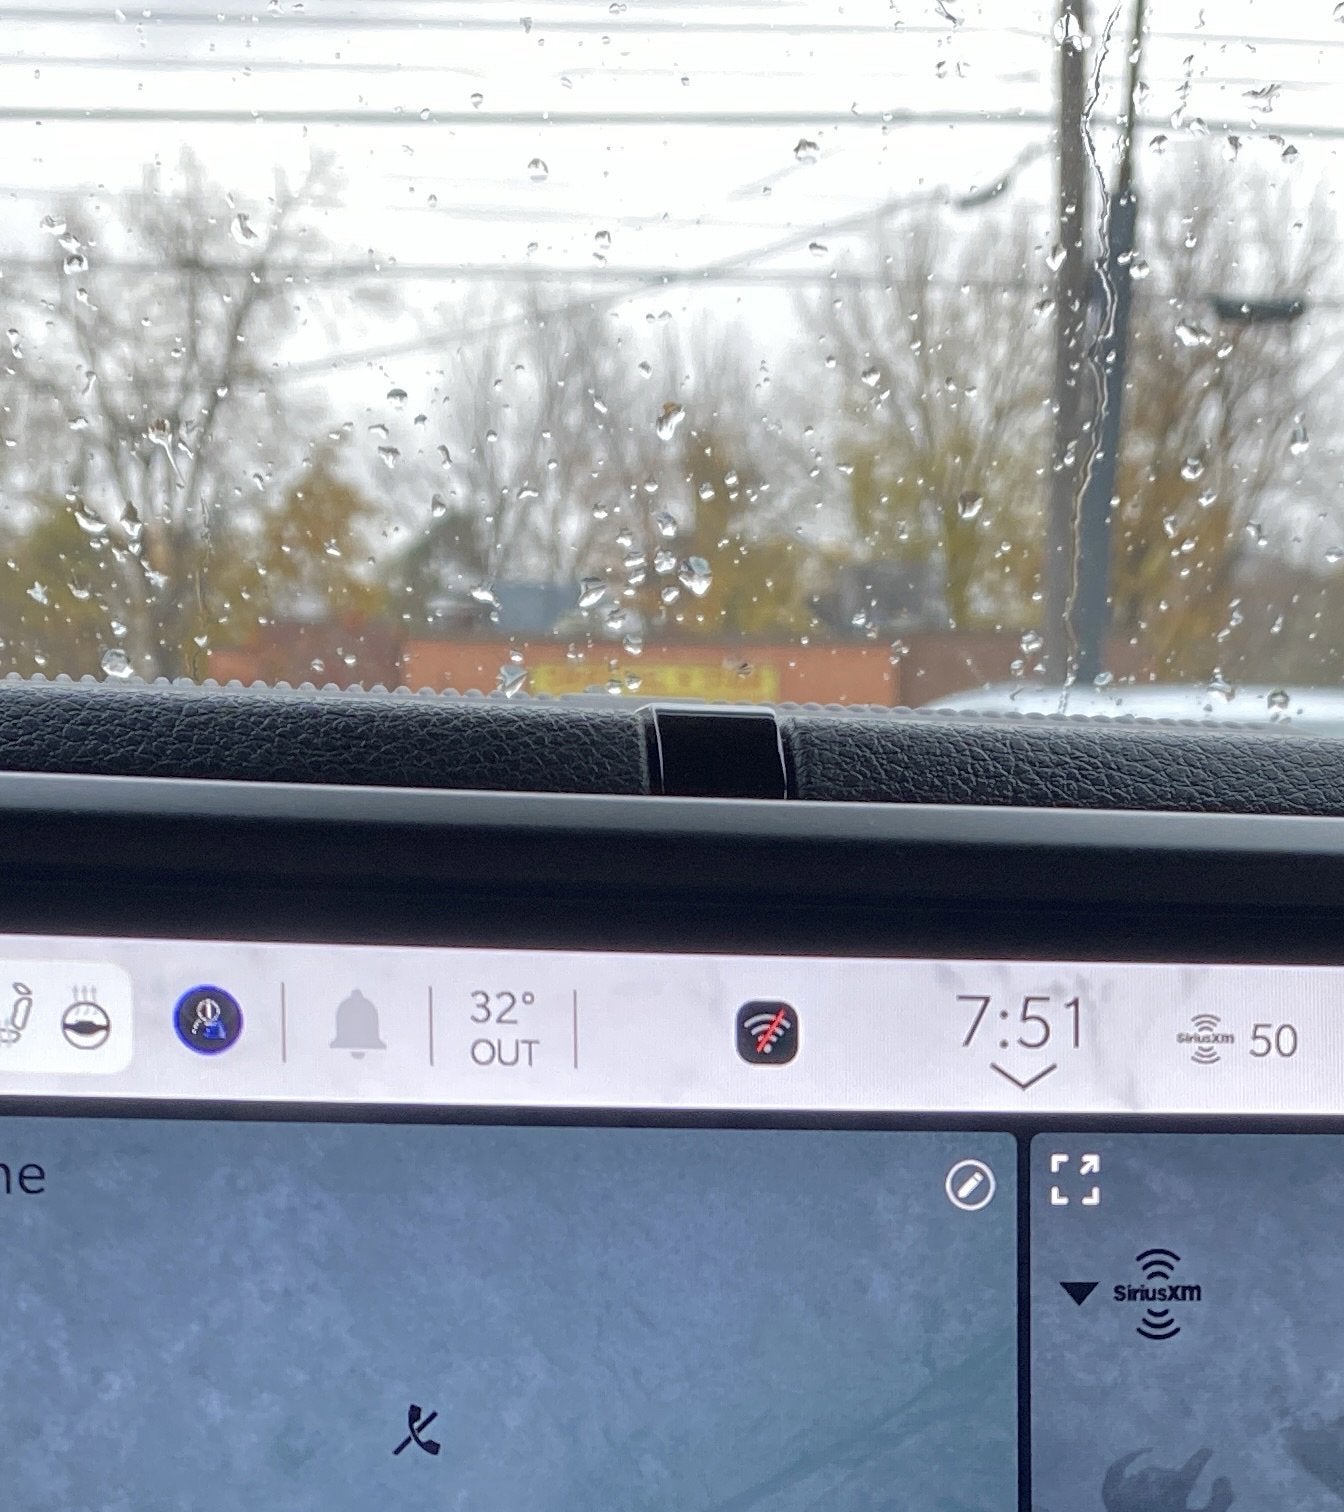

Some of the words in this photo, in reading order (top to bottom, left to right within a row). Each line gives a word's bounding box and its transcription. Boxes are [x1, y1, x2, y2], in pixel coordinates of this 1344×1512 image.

[469, 990, 535, 1025] 32°
[955, 994, 1081, 1050] 7:51
[470, 1038, 540, 1068] OUT
[1249, 1022, 1298, 1058] 50
